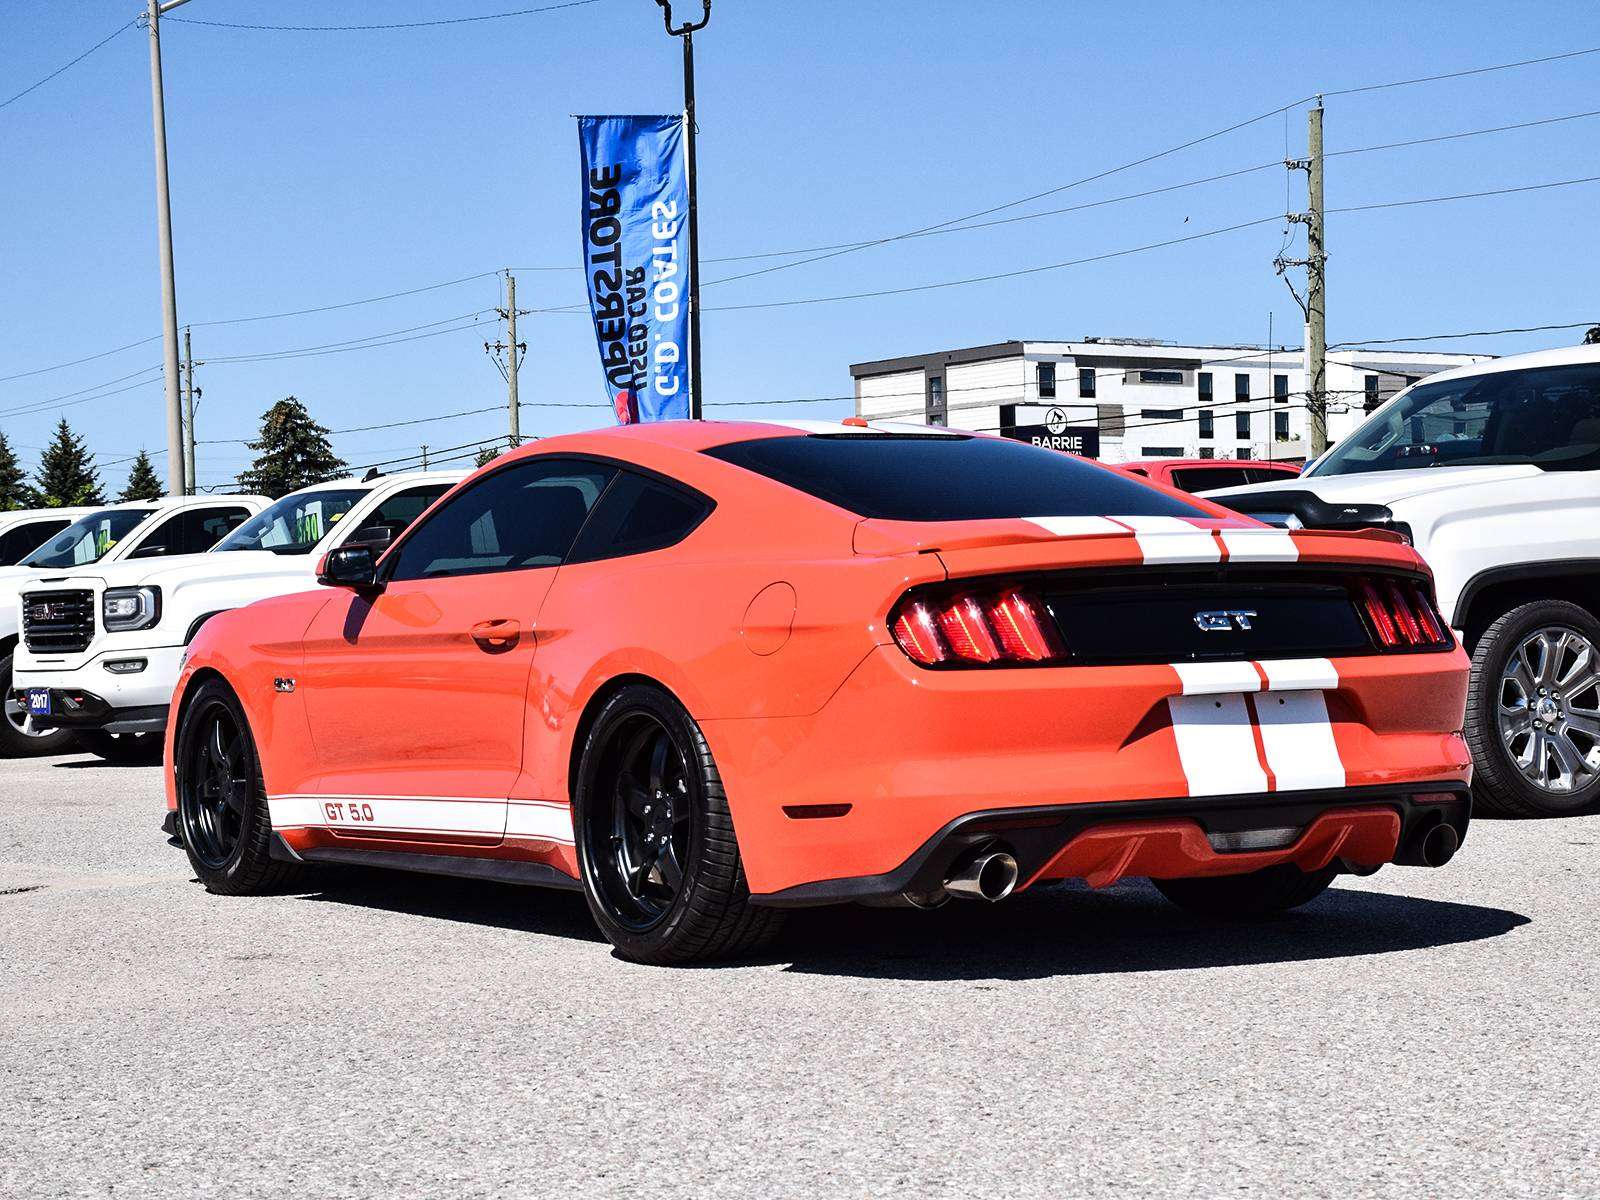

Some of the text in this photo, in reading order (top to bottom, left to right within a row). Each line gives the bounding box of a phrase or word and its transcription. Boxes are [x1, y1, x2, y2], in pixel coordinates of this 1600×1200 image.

[1031, 436, 1083, 449] BARRIE
[33, 602, 65, 620] GMC
[1193, 609, 1258, 631] GT
[30, 693, 48, 709] 2017
[324, 802, 375, 821] GT 5.0
